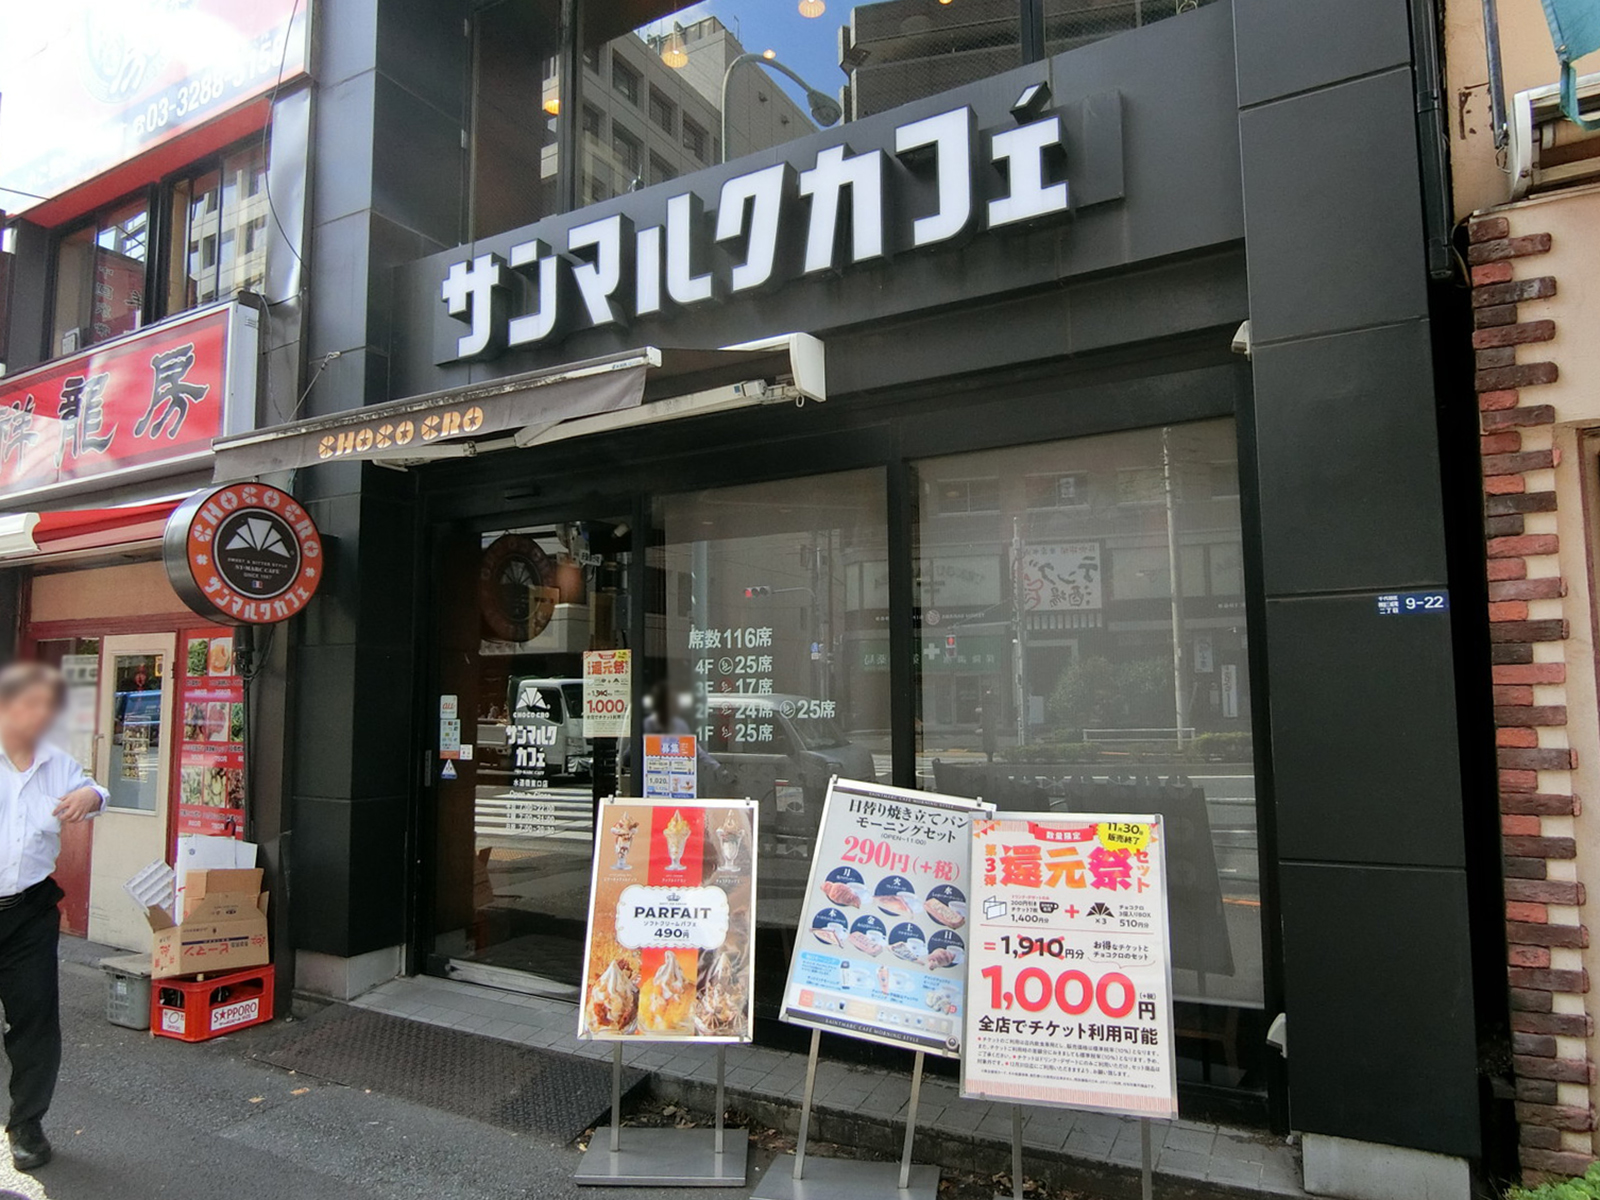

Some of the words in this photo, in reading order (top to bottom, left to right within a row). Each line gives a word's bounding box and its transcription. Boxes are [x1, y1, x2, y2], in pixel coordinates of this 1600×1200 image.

[318, 420, 415, 459] CHOCO
[421, 406, 484, 441] CRO
[194, 486, 280, 542] CHOCO
[284, 504, 319, 558] CRO
[1405, 596, 1444, 610] 9-22
[688, 626, 773, 650] 席数116席
[695, 658, 714, 675] 4F
[734, 655, 773, 674] 25席
[695, 681, 714, 697] 3F
[735, 677, 773, 696] 17席
[734, 700, 774, 719] 24席
[797, 700, 836, 719] 25席
[505, 725, 558, 745] サンマルク
[696, 726, 714, 742] 1F
[734, 723, 774, 742] 25席
[515, 747, 546, 767] カフェ
[848, 799, 969, 829] 日替り焼き立てパン
[856, 816, 956, 843] モーニングセット
[1046, 831, 1081, 841] 数量限定
[1107, 833, 1140, 845] 販売終了
[843, 868, 852, 877] 月
[999, 844, 1134, 892] 還元祭
[1134, 848, 1151, 894] セット
[893, 877, 903, 886] 火
[943, 886, 953, 895] 水
[634, 906, 712, 919] PARFAIT
[828, 909, 838, 918] 木
[1011, 913, 1049, 923] 1,400円分
[866, 915, 876, 925] 金
[1119, 919, 1149, 929] 510円分
[654, 928, 690, 939] 490円
[944, 931, 953, 940] 日
[1093, 940, 1149, 952] お得なチケットと
[1093, 951, 1149, 961] チョコクロのセット
[978, 1015, 1158, 1046] 全店でチケット利用可能
